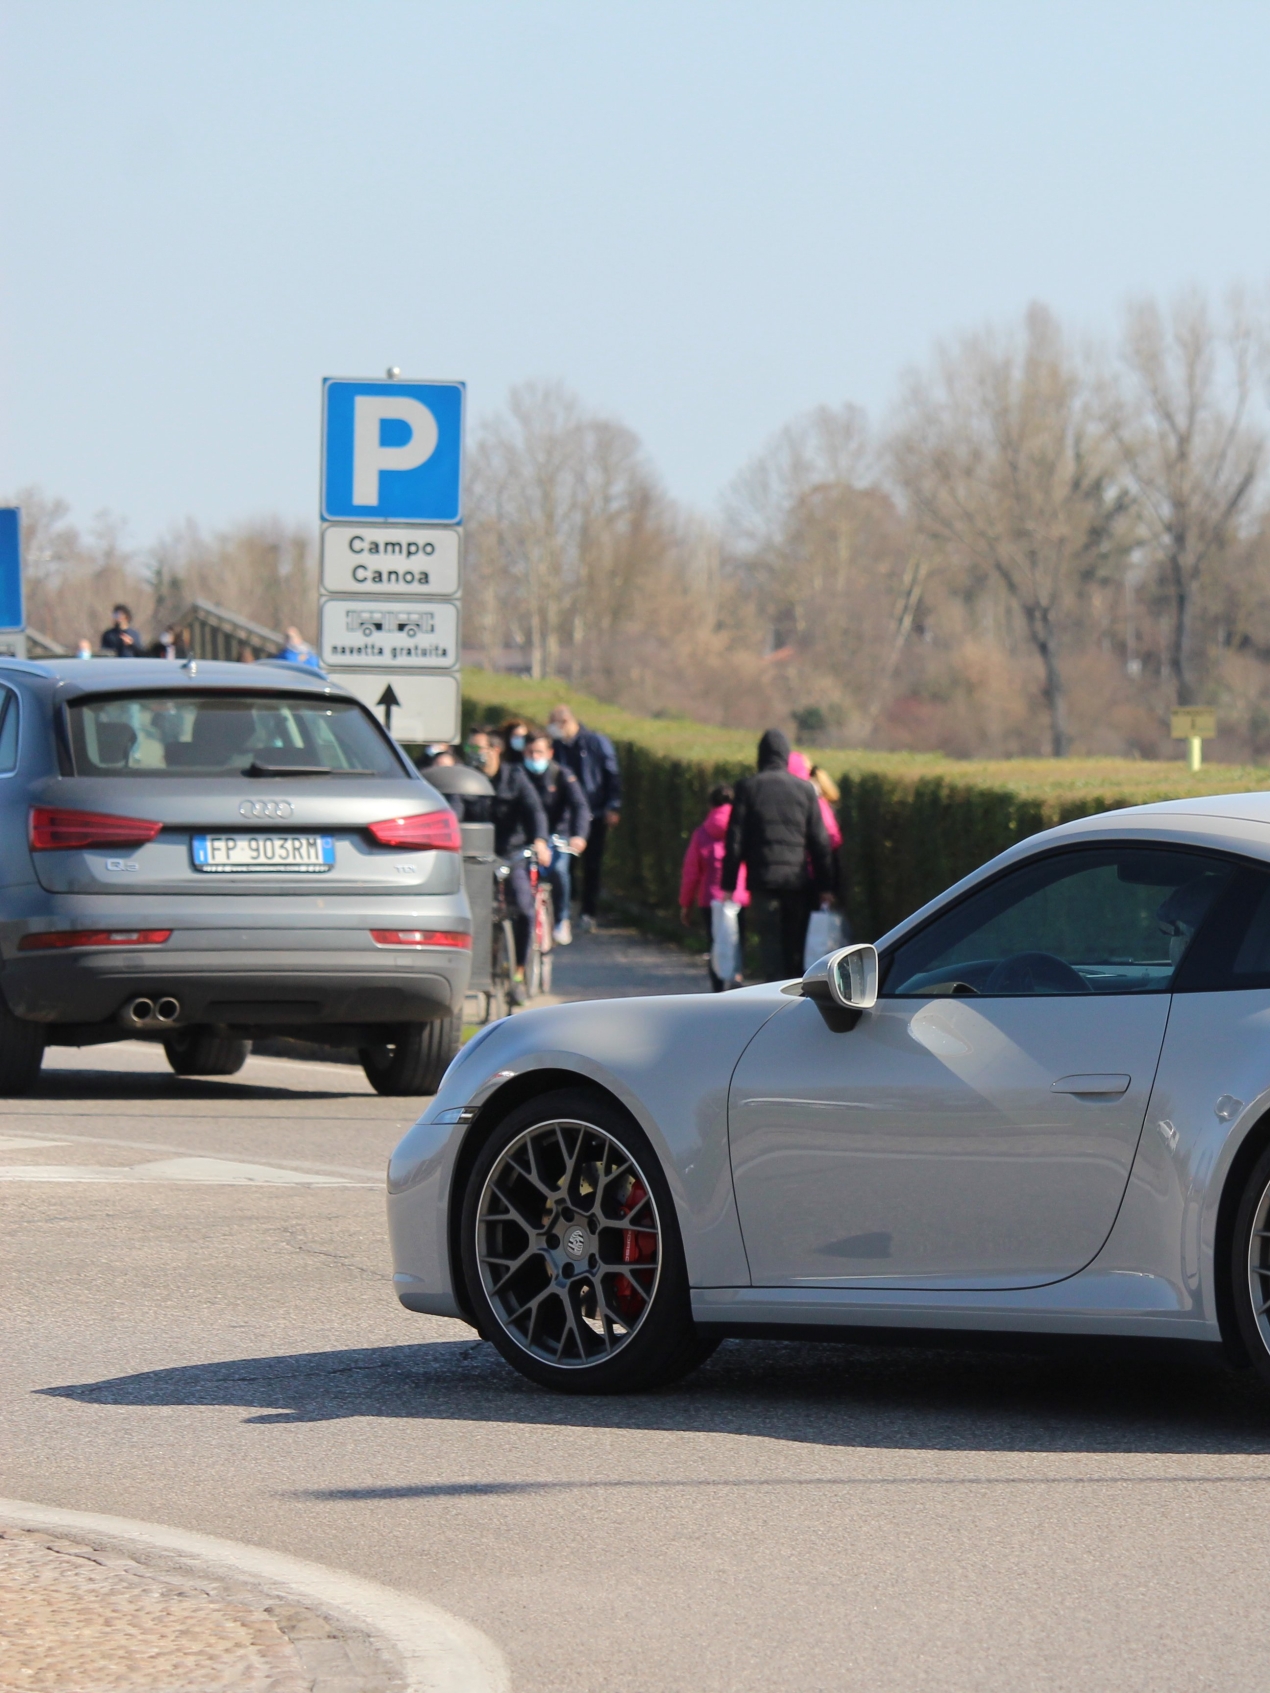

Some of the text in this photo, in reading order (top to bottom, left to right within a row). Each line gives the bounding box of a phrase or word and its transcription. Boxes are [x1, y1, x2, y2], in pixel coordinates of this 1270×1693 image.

[352, 395, 439, 507] P
[349, 535, 435, 558] Campo
[352, 564, 429, 584] Canoa
[331, 643, 447, 660] navetta gratuita
[210, 837, 320, 861] FP 903RM
